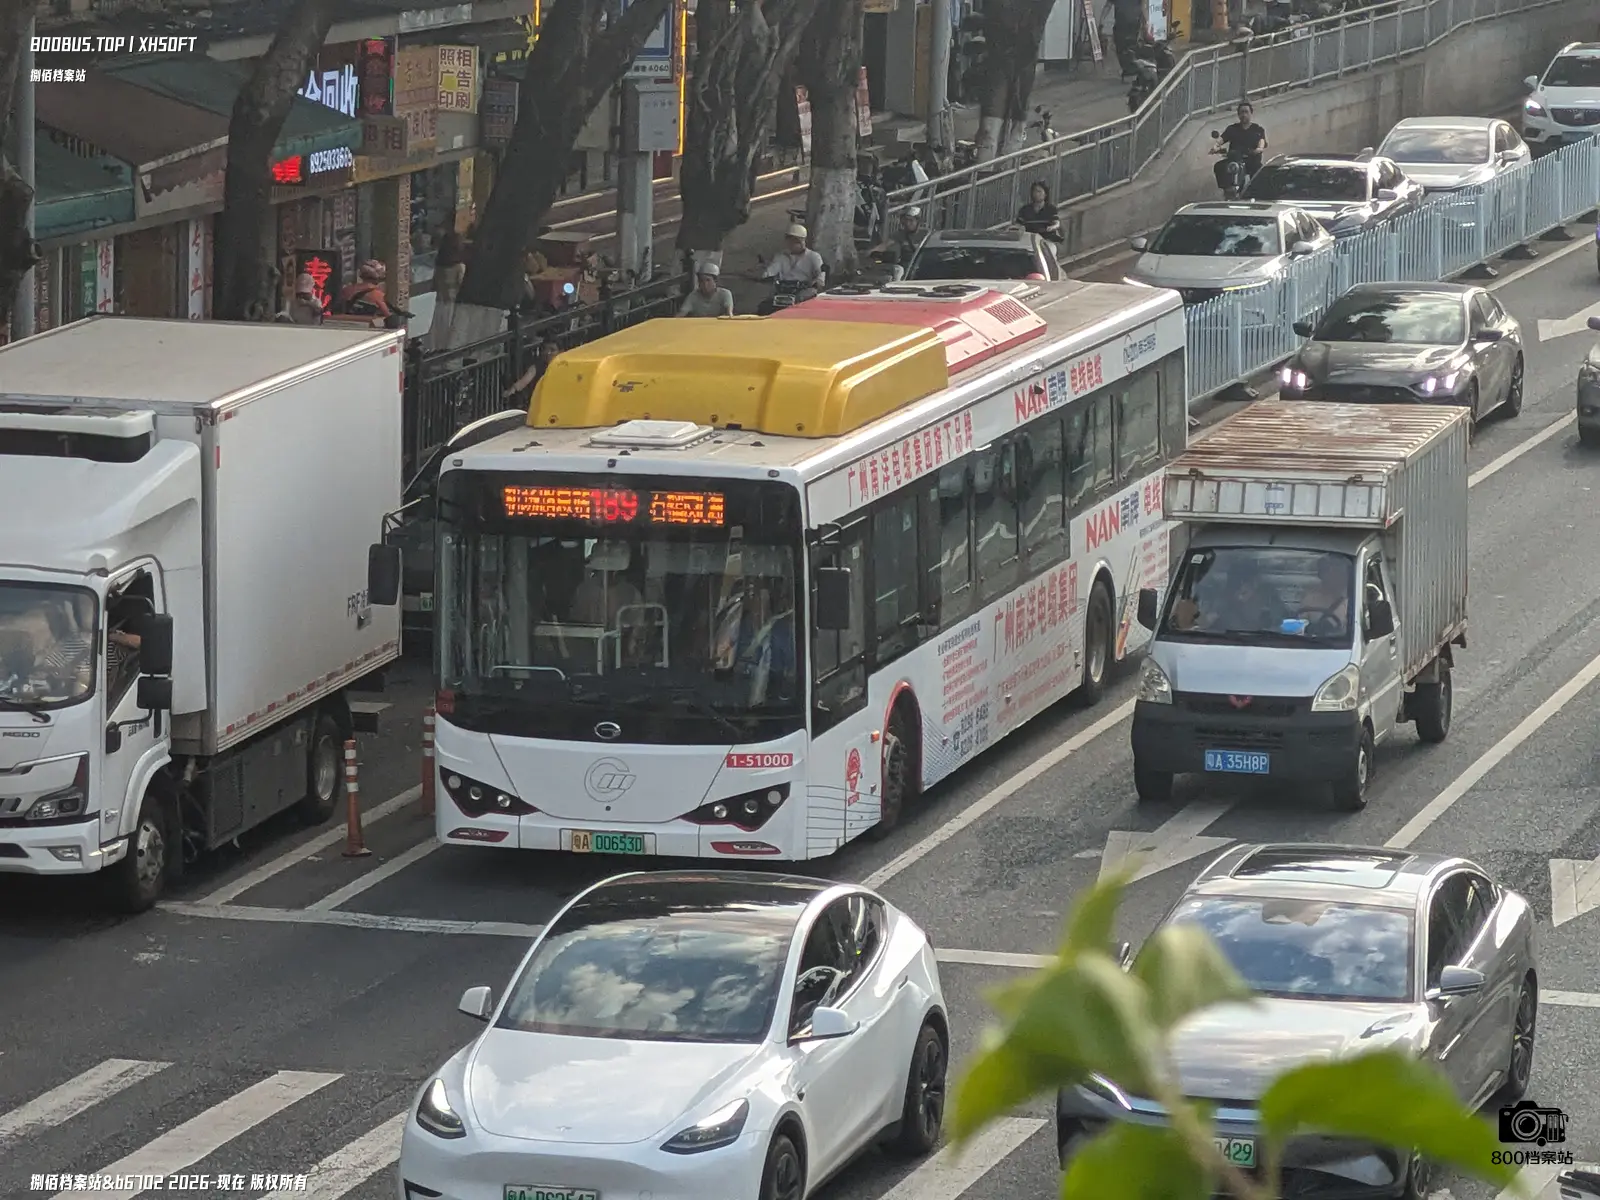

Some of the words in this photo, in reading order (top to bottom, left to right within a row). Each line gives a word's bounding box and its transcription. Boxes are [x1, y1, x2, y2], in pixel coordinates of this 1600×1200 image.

[440, 49, 472, 67] 照相
[439, 70, 472, 89] 广告
[297, 64, 358, 118] 回收
[439, 90, 471, 110] 印刷
[993, 561, 1078, 663] 广州南洋电缆集团
[731, 754, 790, 767] 1-51000
